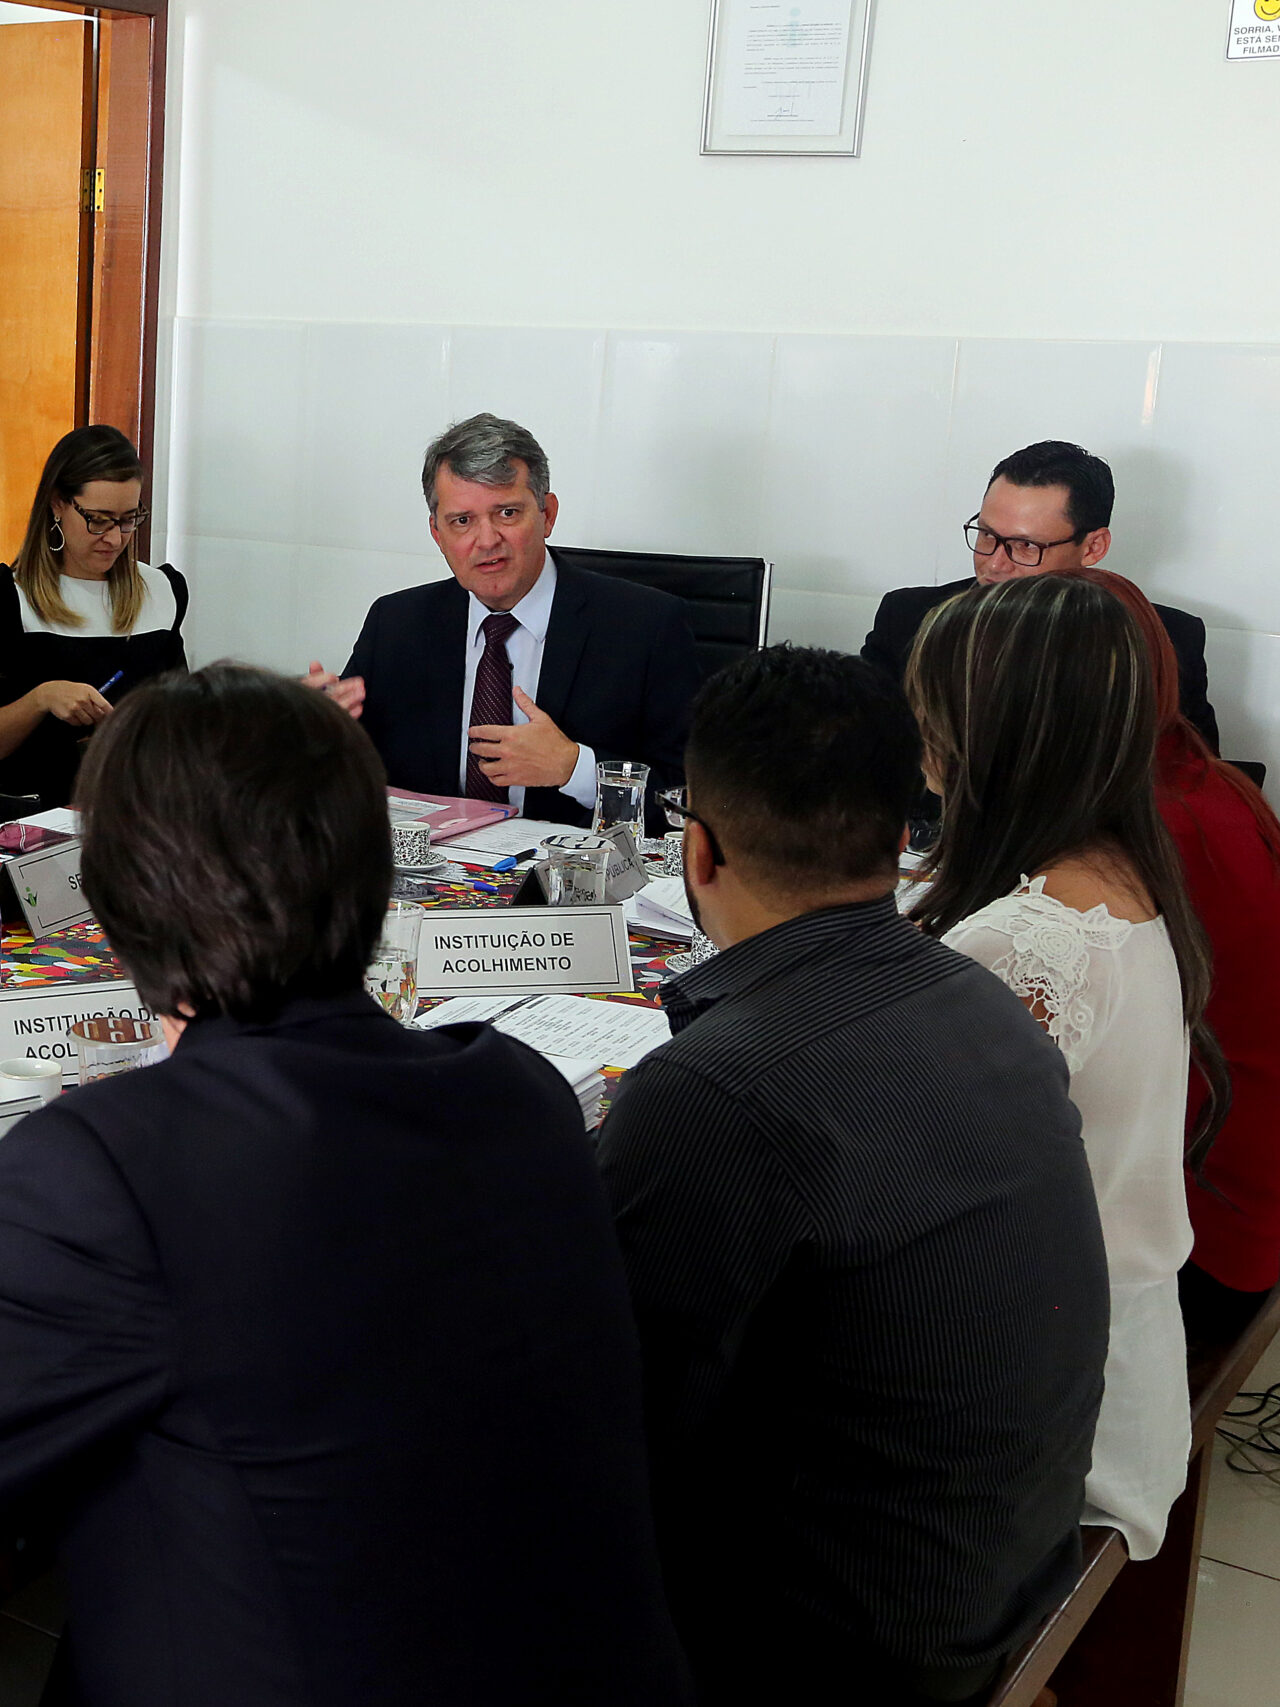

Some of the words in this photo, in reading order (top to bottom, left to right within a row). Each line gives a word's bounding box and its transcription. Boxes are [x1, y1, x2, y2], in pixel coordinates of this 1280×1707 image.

[434, 930, 546, 951] INSTITUIÇÃO
[551, 932, 575, 946] DE
[442, 957, 572, 973] ACOLHIMENTO
